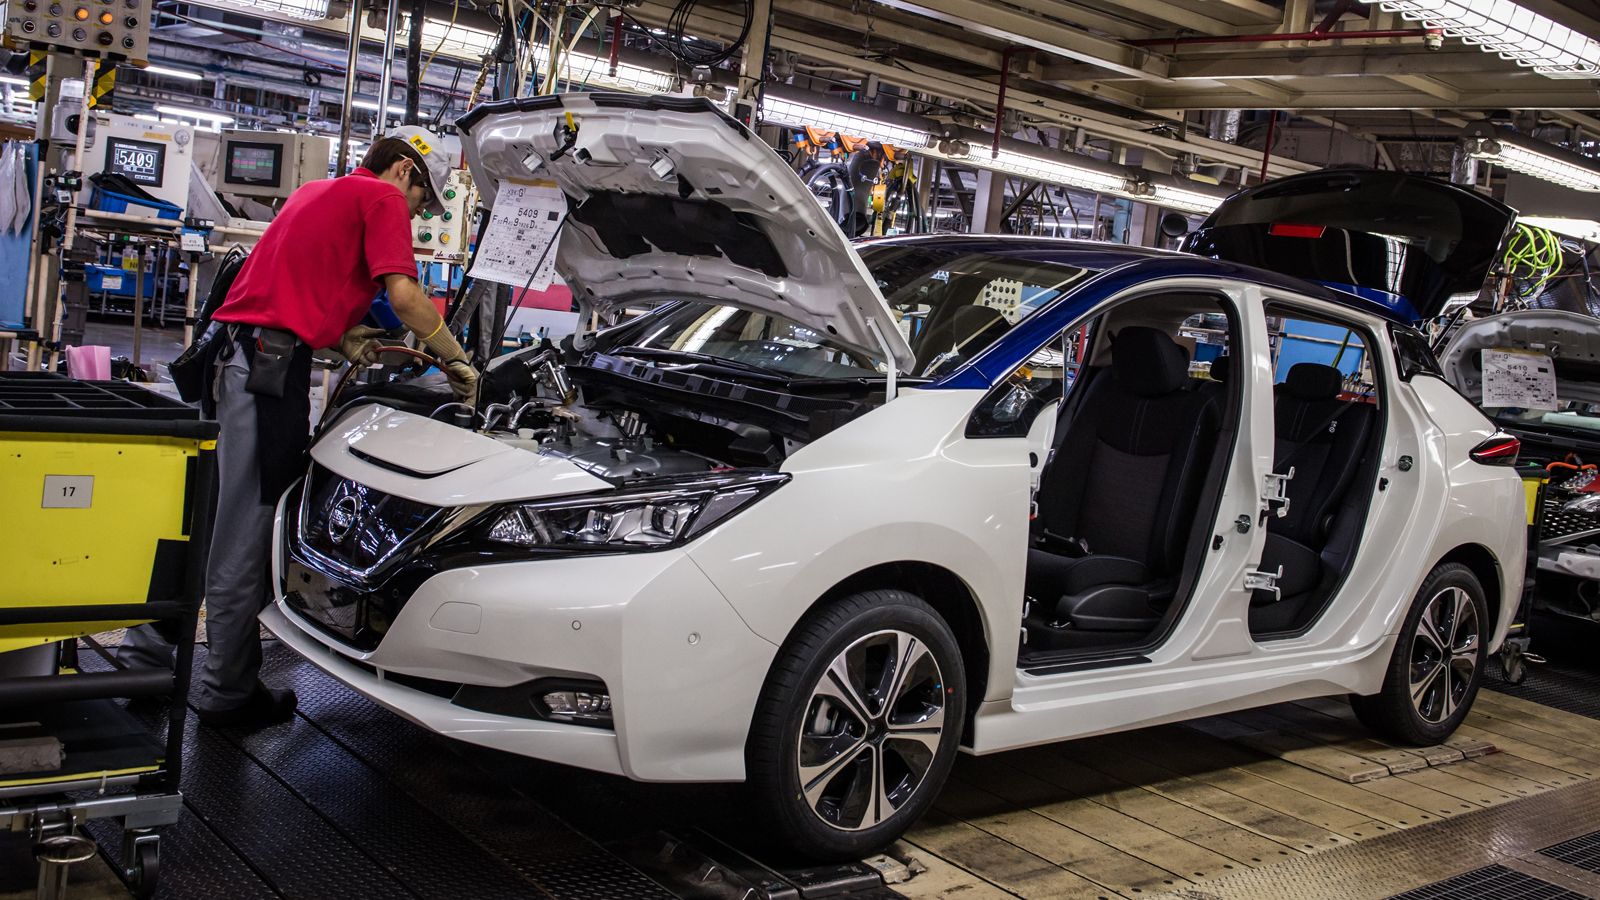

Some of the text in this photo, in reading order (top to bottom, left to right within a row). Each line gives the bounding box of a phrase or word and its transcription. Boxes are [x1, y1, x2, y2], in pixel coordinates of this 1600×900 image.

[119, 150, 154, 168] 5409
[517, 207, 539, 219] 5409
[62, 486, 76, 497] 17
